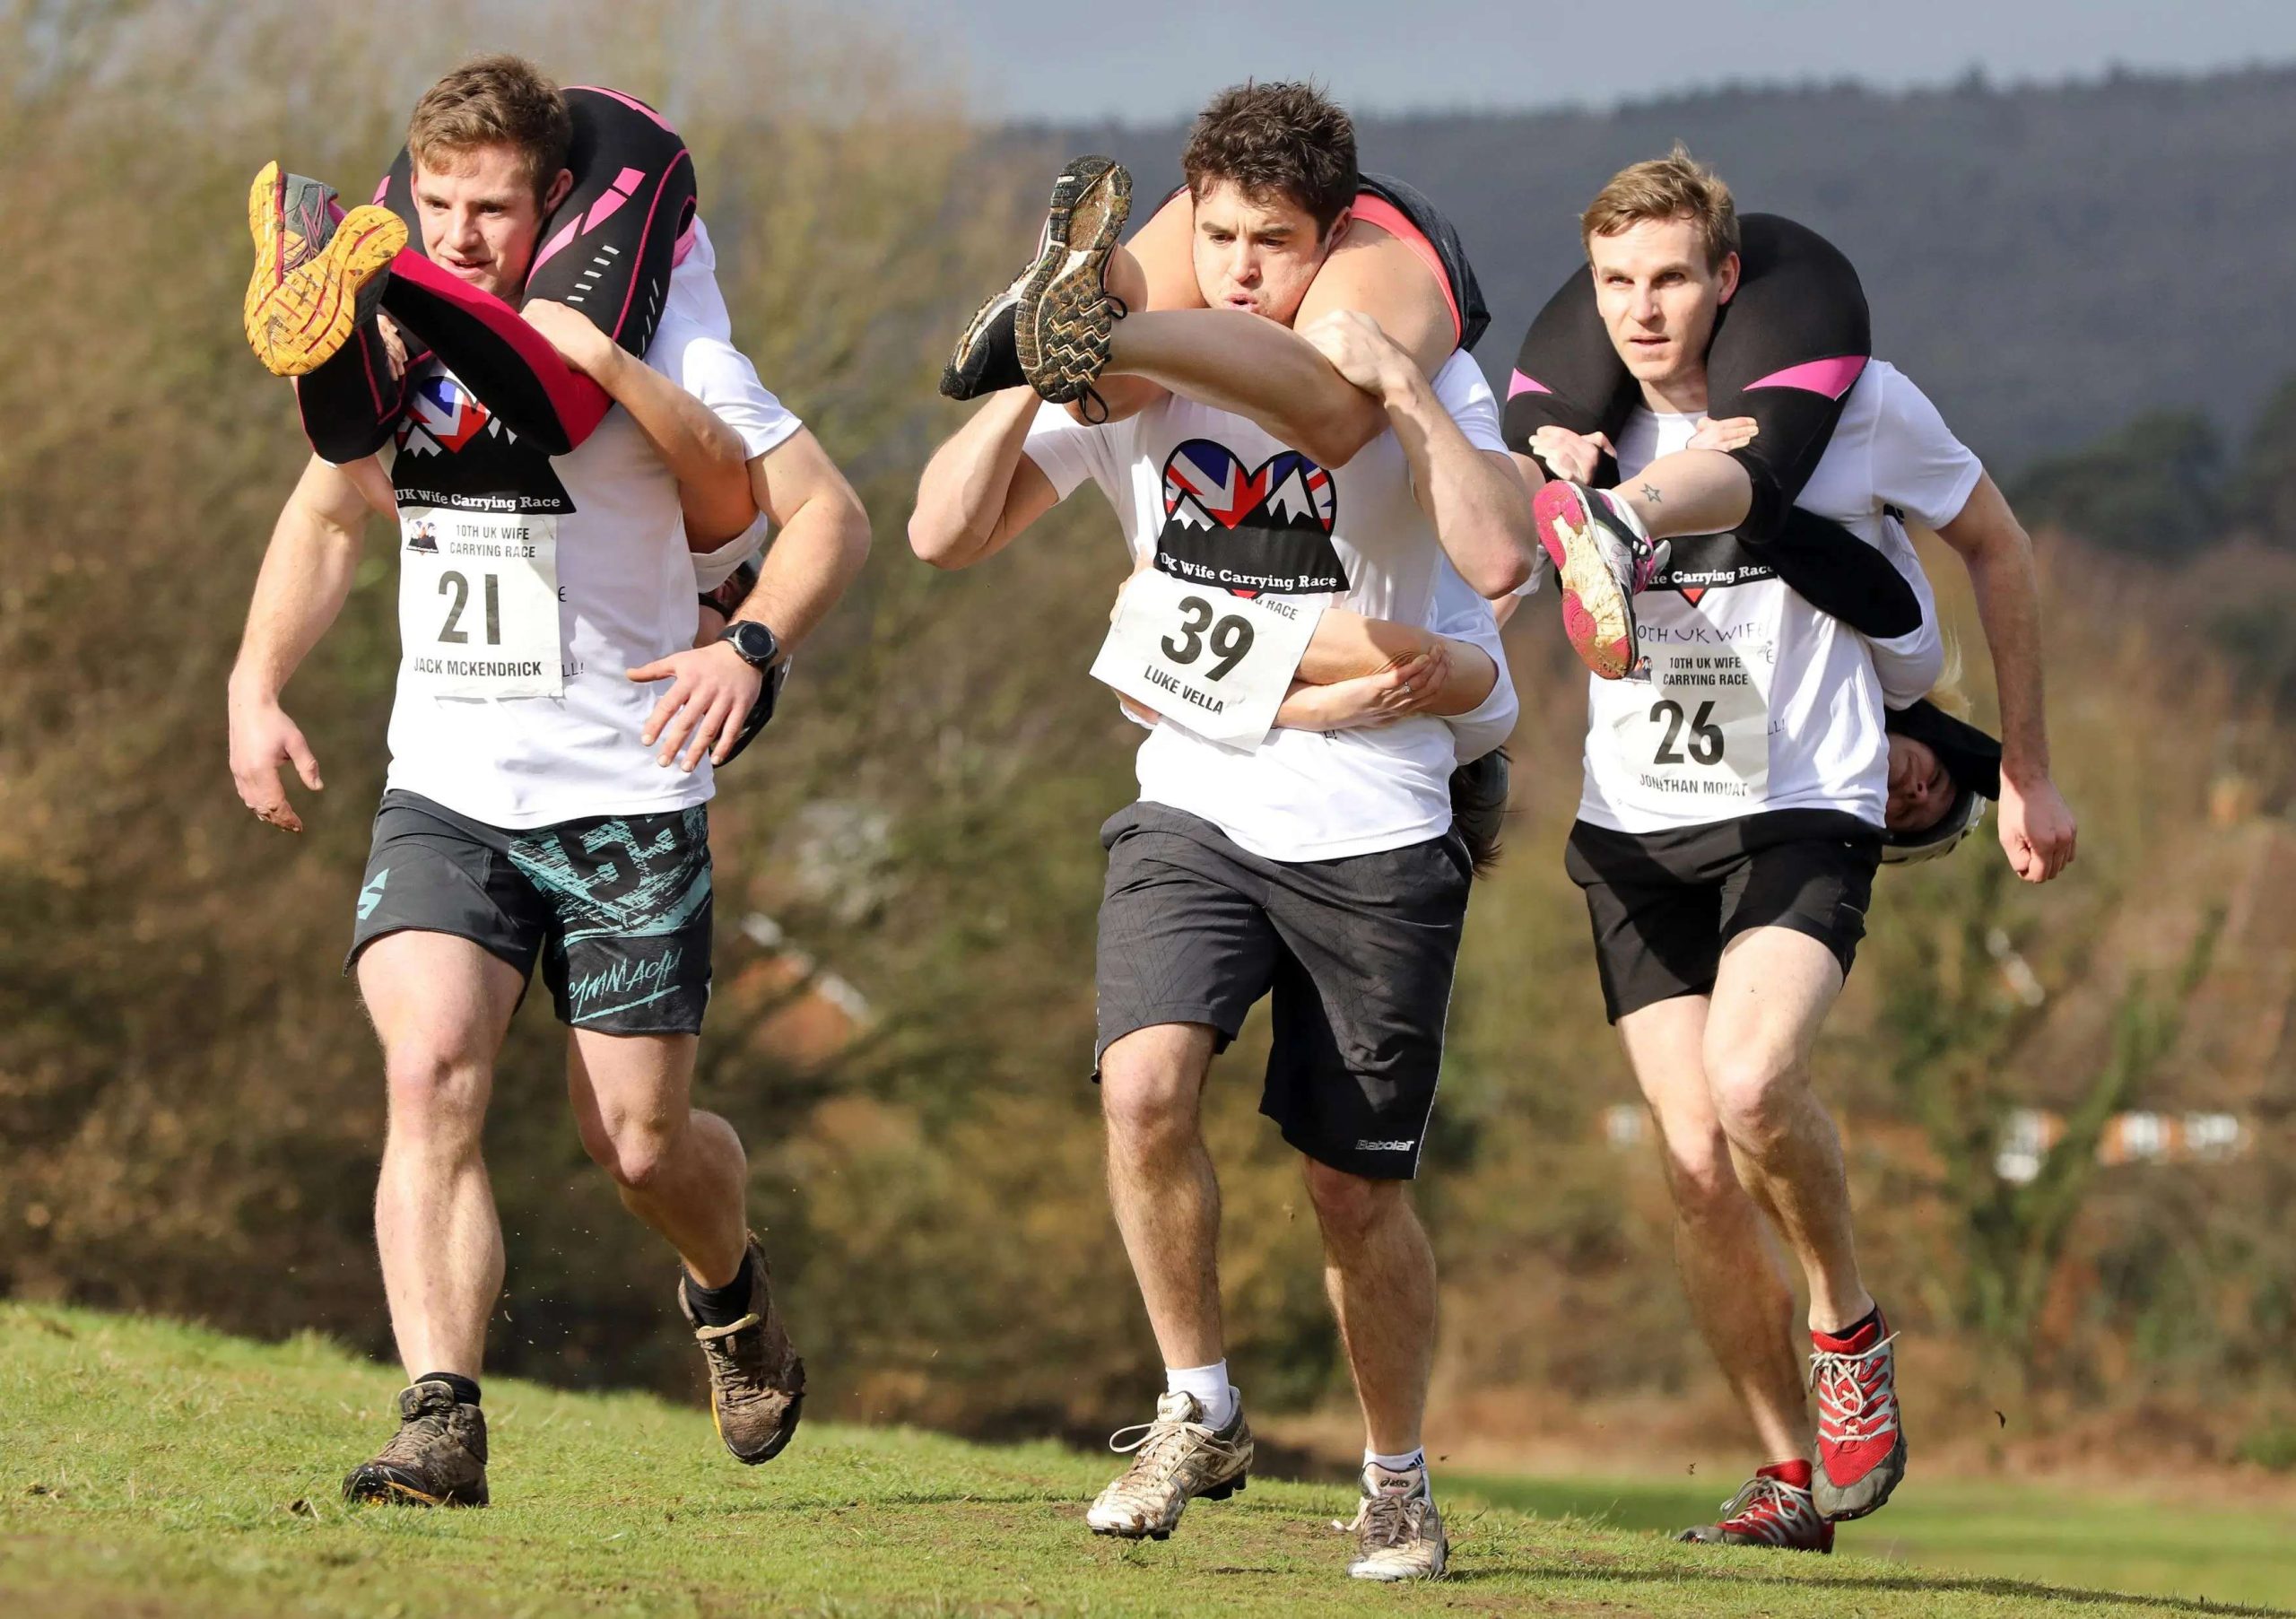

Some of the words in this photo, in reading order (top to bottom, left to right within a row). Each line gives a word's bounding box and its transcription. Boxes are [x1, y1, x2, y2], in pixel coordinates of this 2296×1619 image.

[395, 489, 417, 501] UK
[417, 490, 448, 504] Wife
[451, 494, 517, 511] Carrying
[519, 496, 561, 508] Race
[456, 525, 479, 538] 10TH
[483, 526, 497, 539] UK
[501, 527, 530, 540] WIFE
[449, 542, 501, 557] CARRYING
[505, 545, 536, 558] RACE
[1179, 560, 1216, 579] Wife
[1219, 569, 1294, 591] Carrying
[1298, 575, 1337, 588] Race
[1671, 569, 1735, 585] Carrying
[437, 570, 501, 646] 21
[1265, 599, 1299, 621] RACE
[1161, 596, 1255, 683] 39
[1674, 628, 1711, 644] UK
[413, 657, 443, 674] JACK
[447, 660, 543, 677] MCKENDRICK
[1669, 657, 1693, 669] 10TH
[1696, 657, 1711, 669] UK
[1714, 656, 1742, 668] WIFE
[1144, 665, 1181, 694] LUKE
[1182, 685, 1224, 716] VELLA
[1663, 674, 1716, 686] CARRYING
[1718, 674, 1749, 686] RACE
[1648, 699, 1726, 766] 26
